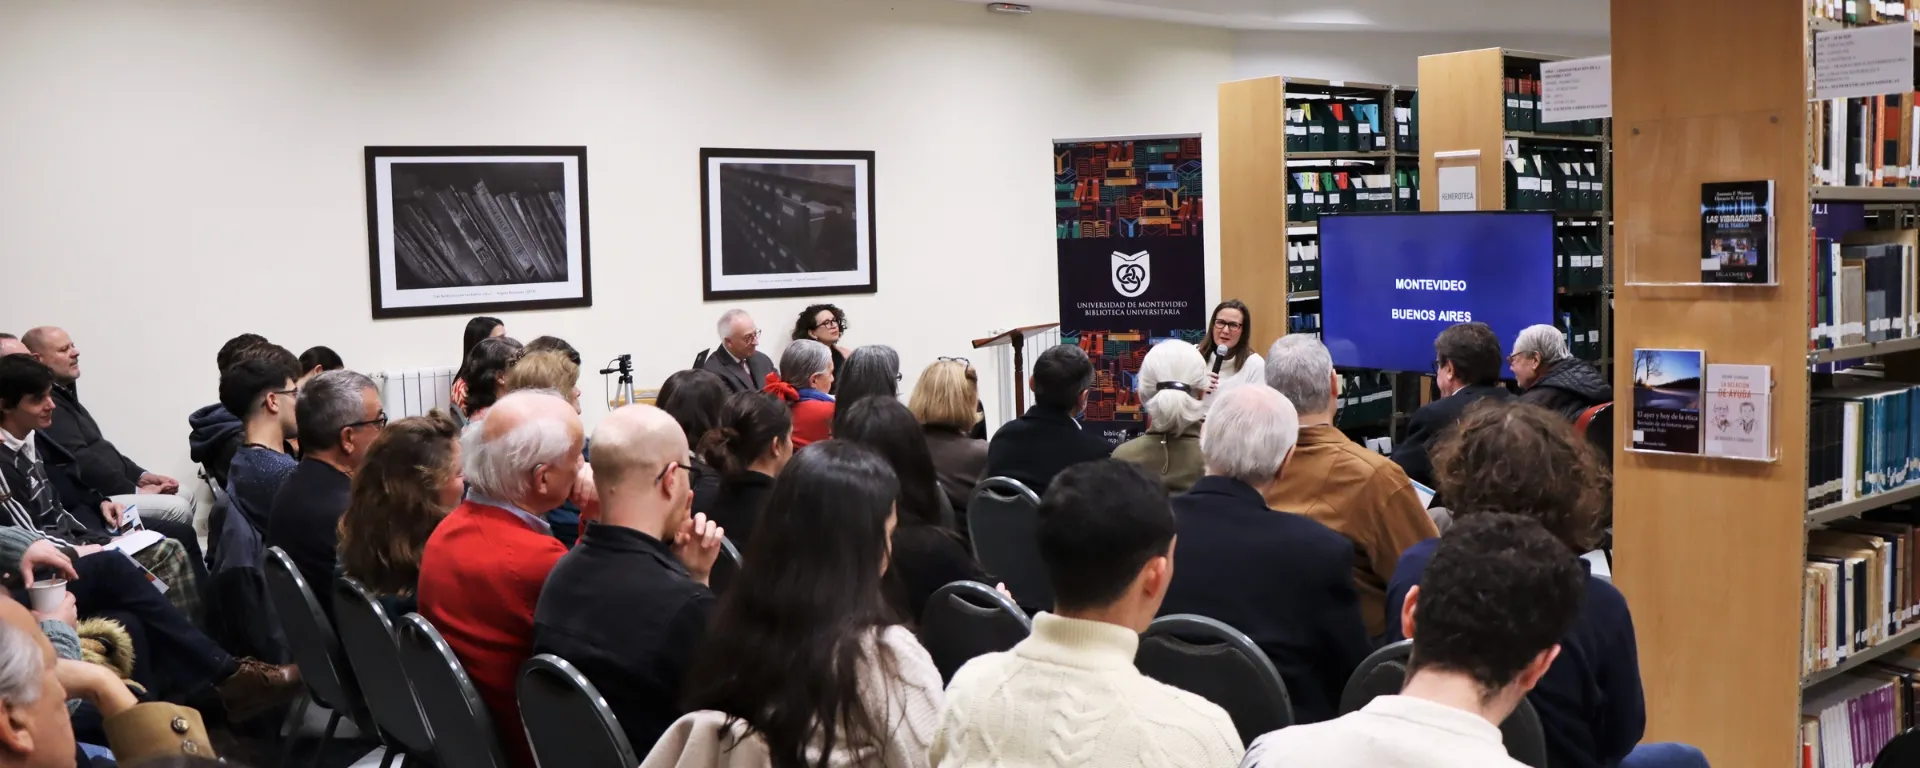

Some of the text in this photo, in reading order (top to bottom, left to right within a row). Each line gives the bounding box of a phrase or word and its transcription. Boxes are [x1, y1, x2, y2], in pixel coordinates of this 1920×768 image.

[1505, 143, 1515, 155] A
[1442, 192, 1474, 200] HEMEROTECA
[1720, 214, 1762, 223] VIBRACIONES
[1395, 278, 1467, 291] MONTEVIDEO
[1391, 308, 1472, 322] BUENOS AIRES
